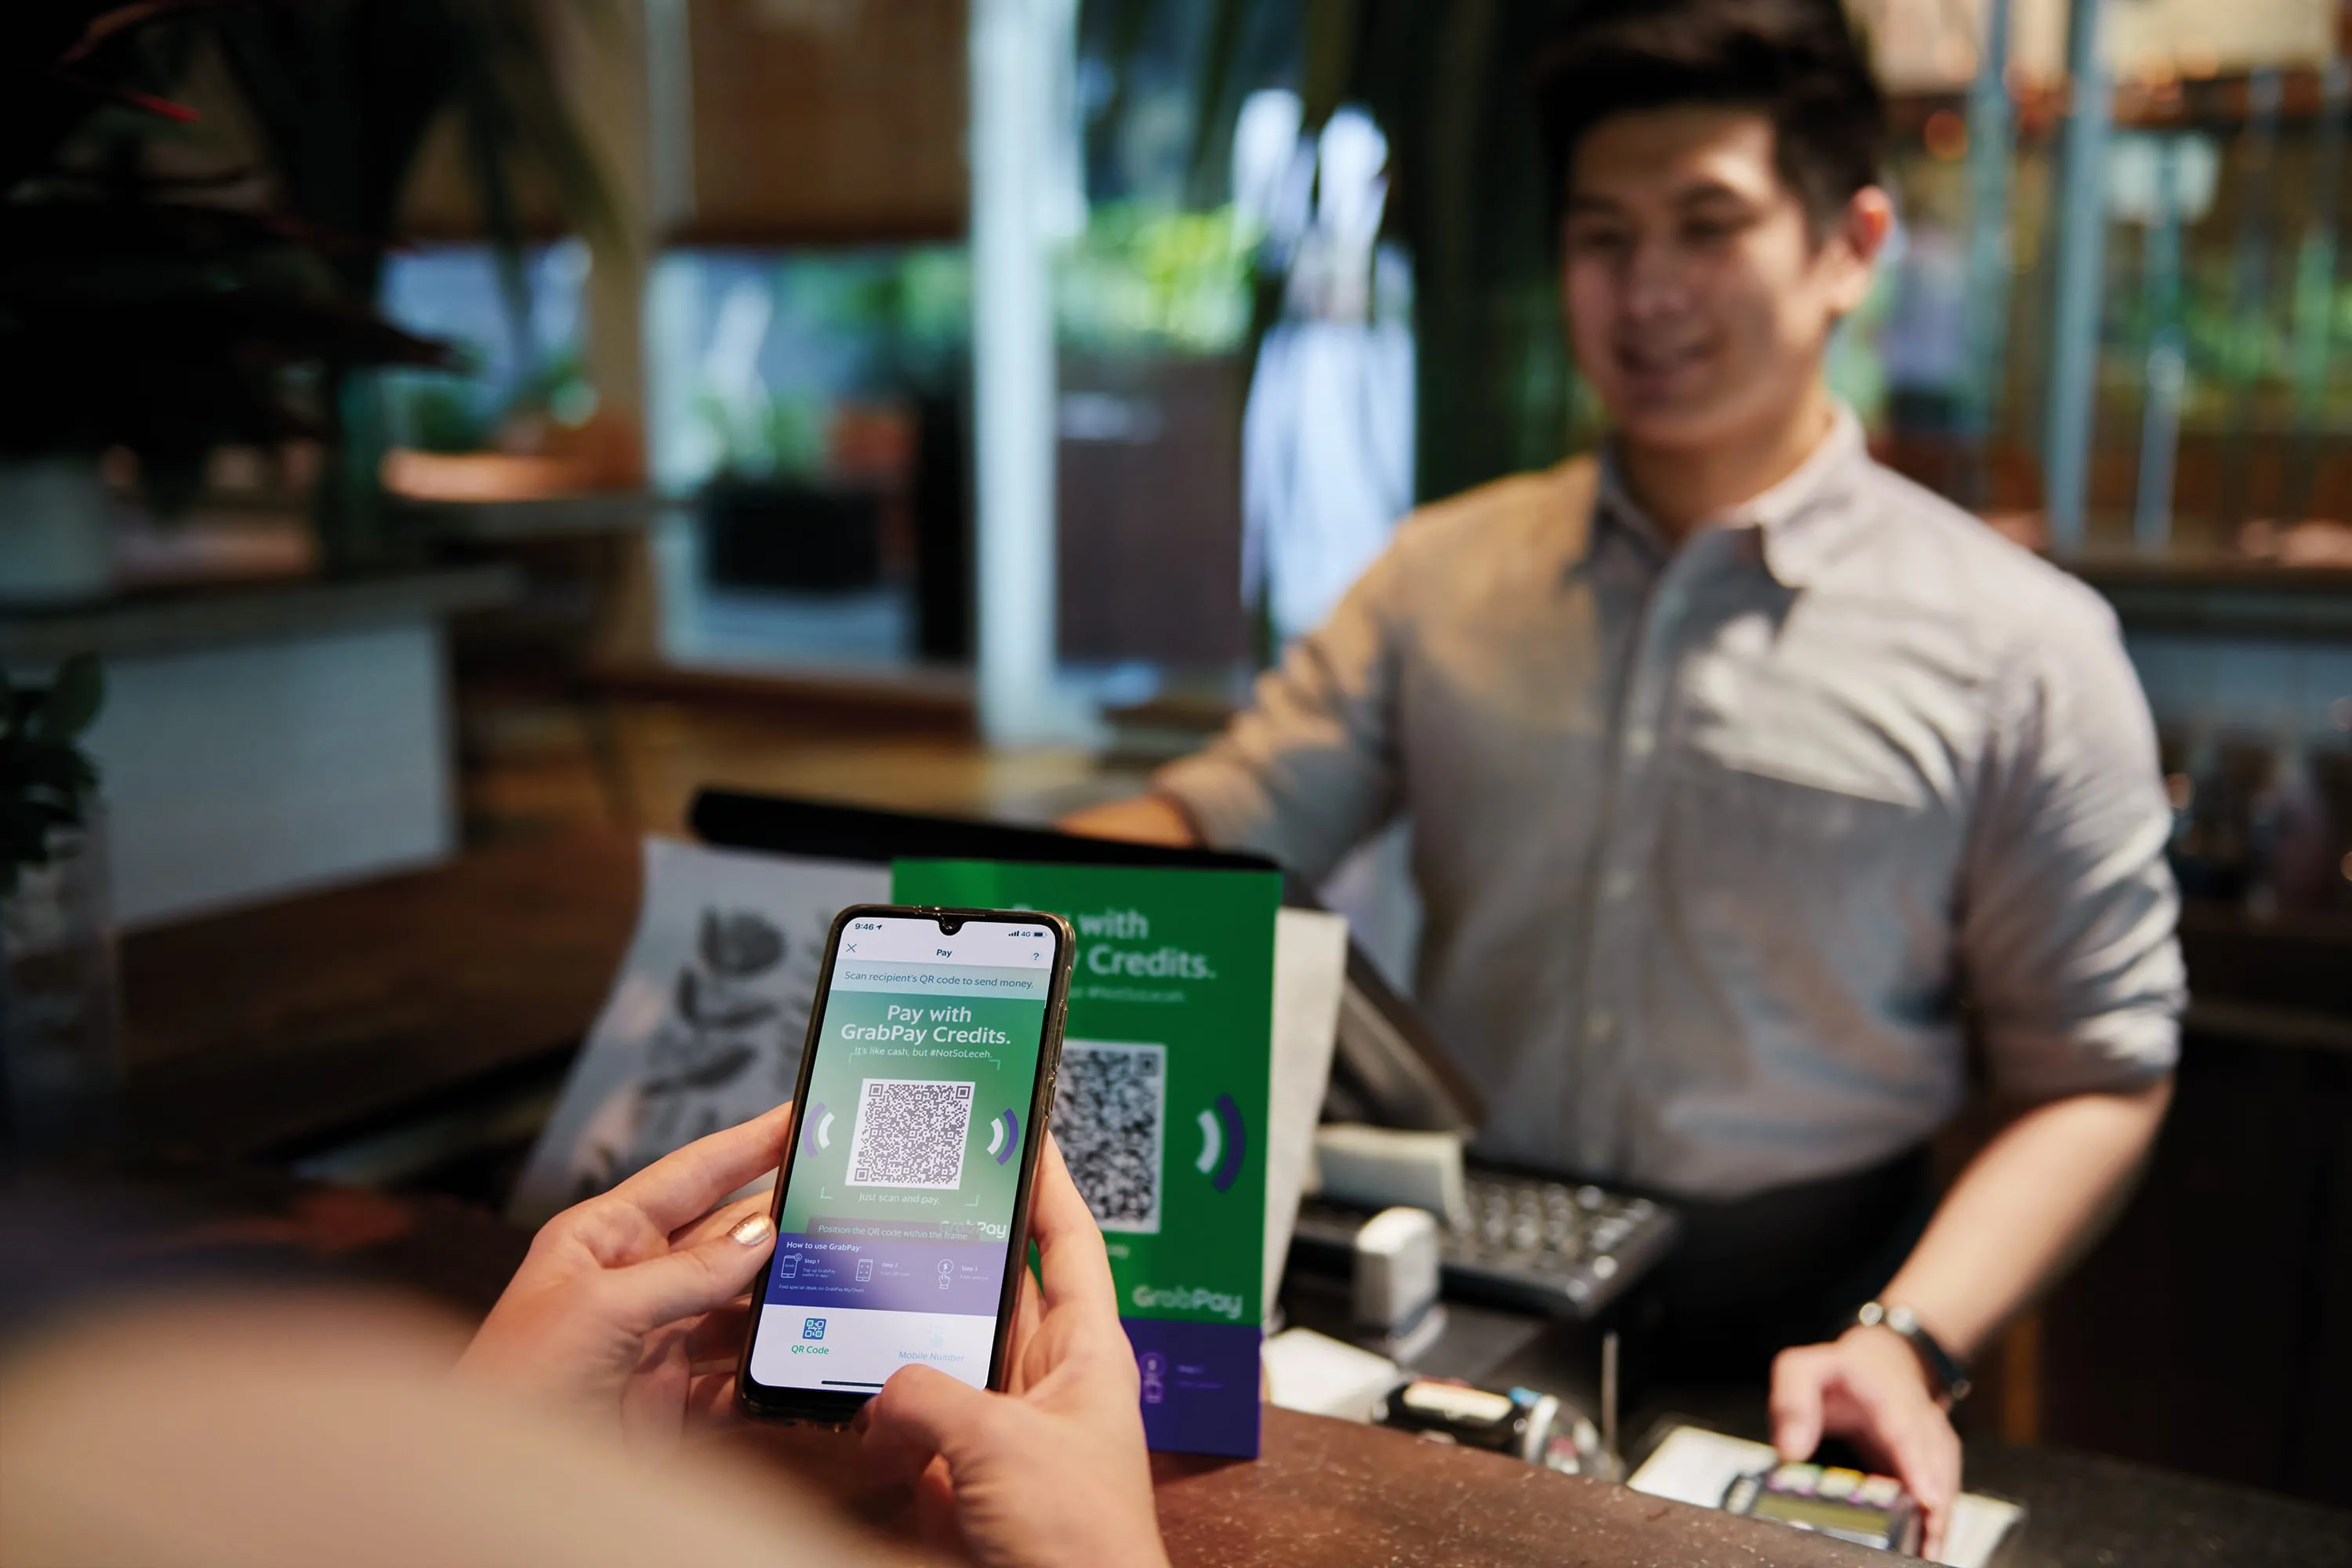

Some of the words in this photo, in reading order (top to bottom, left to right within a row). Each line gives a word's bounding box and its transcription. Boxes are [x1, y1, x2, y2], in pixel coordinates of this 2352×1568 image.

[1078, 906, 1149, 939] with
[936, 949, 953, 957] Pay
[1087, 945, 1217, 978] Credits.
[844, 971, 866, 980] Scan
[869, 972, 917, 982] recipient's
[920, 975, 935, 984] QR
[936, 975, 960, 985] code
[975, 978, 997, 986] send
[1000, 980, 1034, 989] money.
[887, 1004, 924, 1025] Pay
[930, 1006, 972, 1023] with
[840, 1023, 927, 1046] GrabPay
[932, 1026, 1011, 1044] Credits.
[854, 1046, 867, 1055] It's
[869, 1046, 885, 1055] like
[887, 1047, 909, 1057] cash,
[912, 1047, 928, 1057] but
[930, 1049, 993, 1058] #NotSoLeceh.
[858, 1192, 877, 1202] Just
[878, 1194, 900, 1203] scan
[902, 1194, 919, 1203] and
[920, 1196, 941, 1205] pay.
[818, 1225, 851, 1234] Position
[852, 1226, 866, 1235] the
[867, 1227, 880, 1236] QR
[881, 1228, 902, 1237] code
[903, 1229, 927, 1239] within
[928, 1230, 942, 1240] the
[943, 1231, 968, 1241] frame
[1133, 1285, 1243, 1319] GrabPay
[791, 1345, 804, 1355] QR
[806, 1345, 829, 1355] Code
[898, 1351, 928, 1360] Mobile
[929, 1352, 965, 1363] Number
